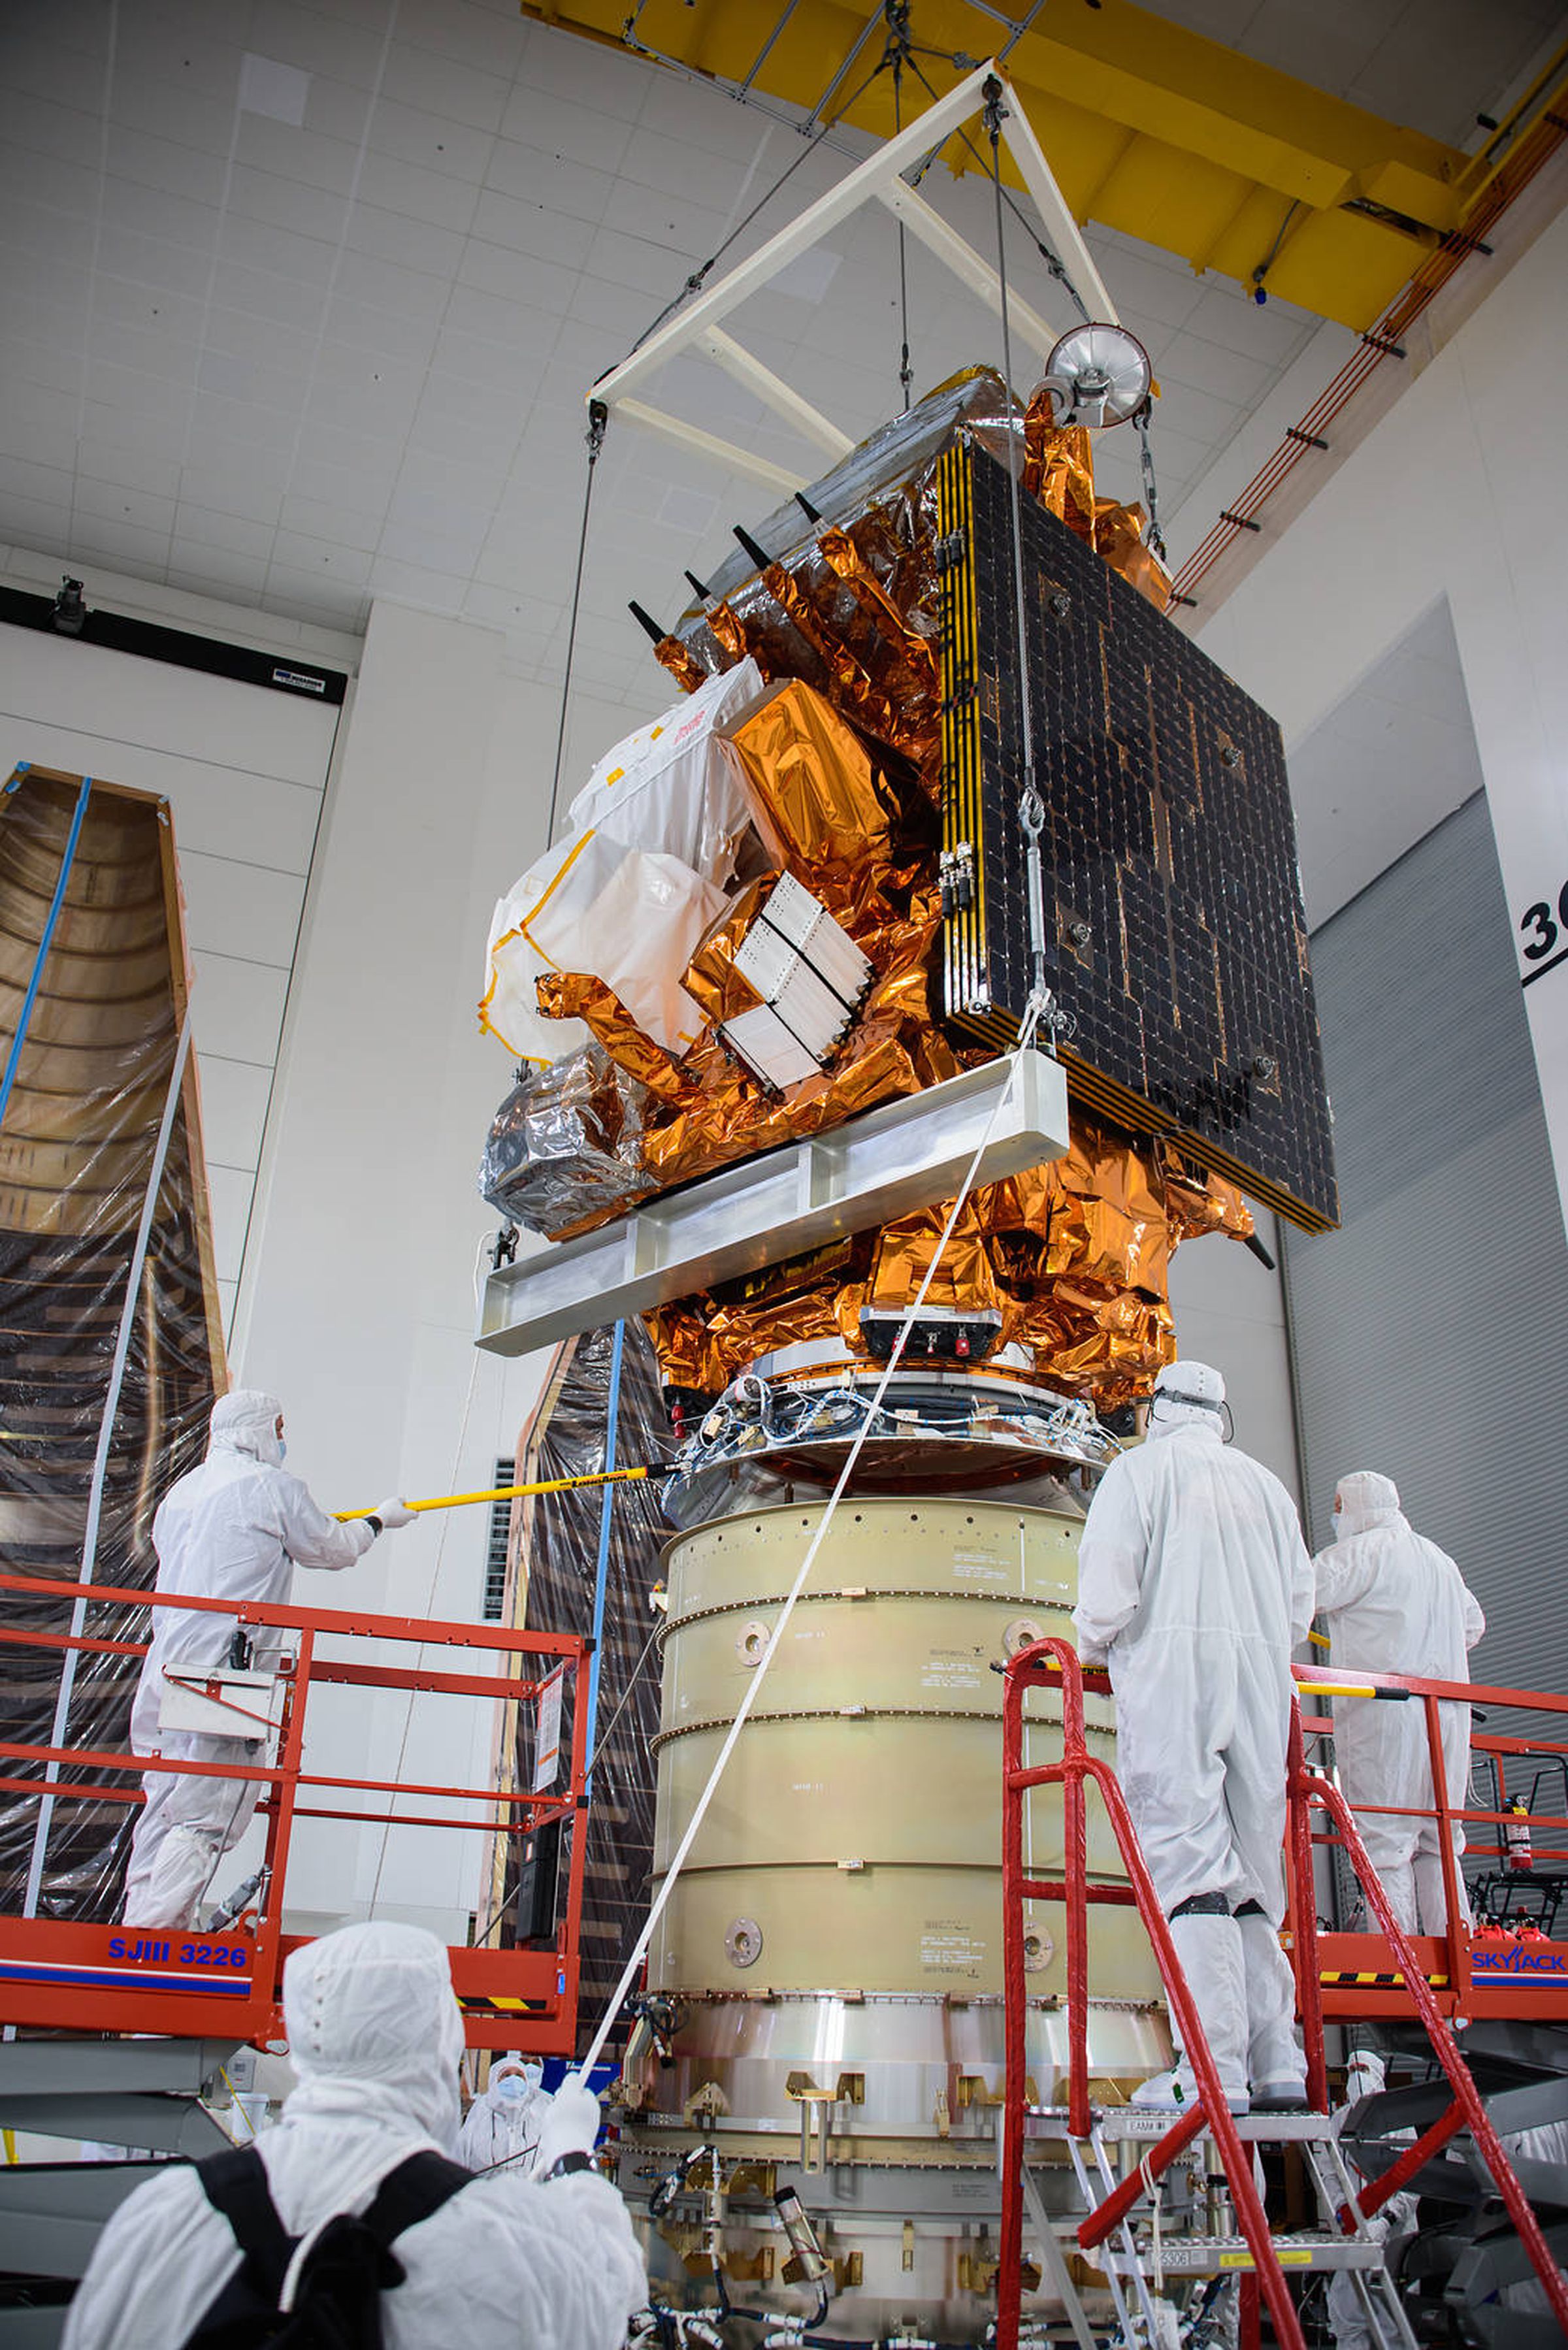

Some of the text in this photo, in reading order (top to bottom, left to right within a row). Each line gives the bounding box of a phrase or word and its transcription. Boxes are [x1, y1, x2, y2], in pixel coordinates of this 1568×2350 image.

[108, 1938, 246, 1968] SJIII 3226
[1471, 1946, 1567, 1972] SKYJACK
